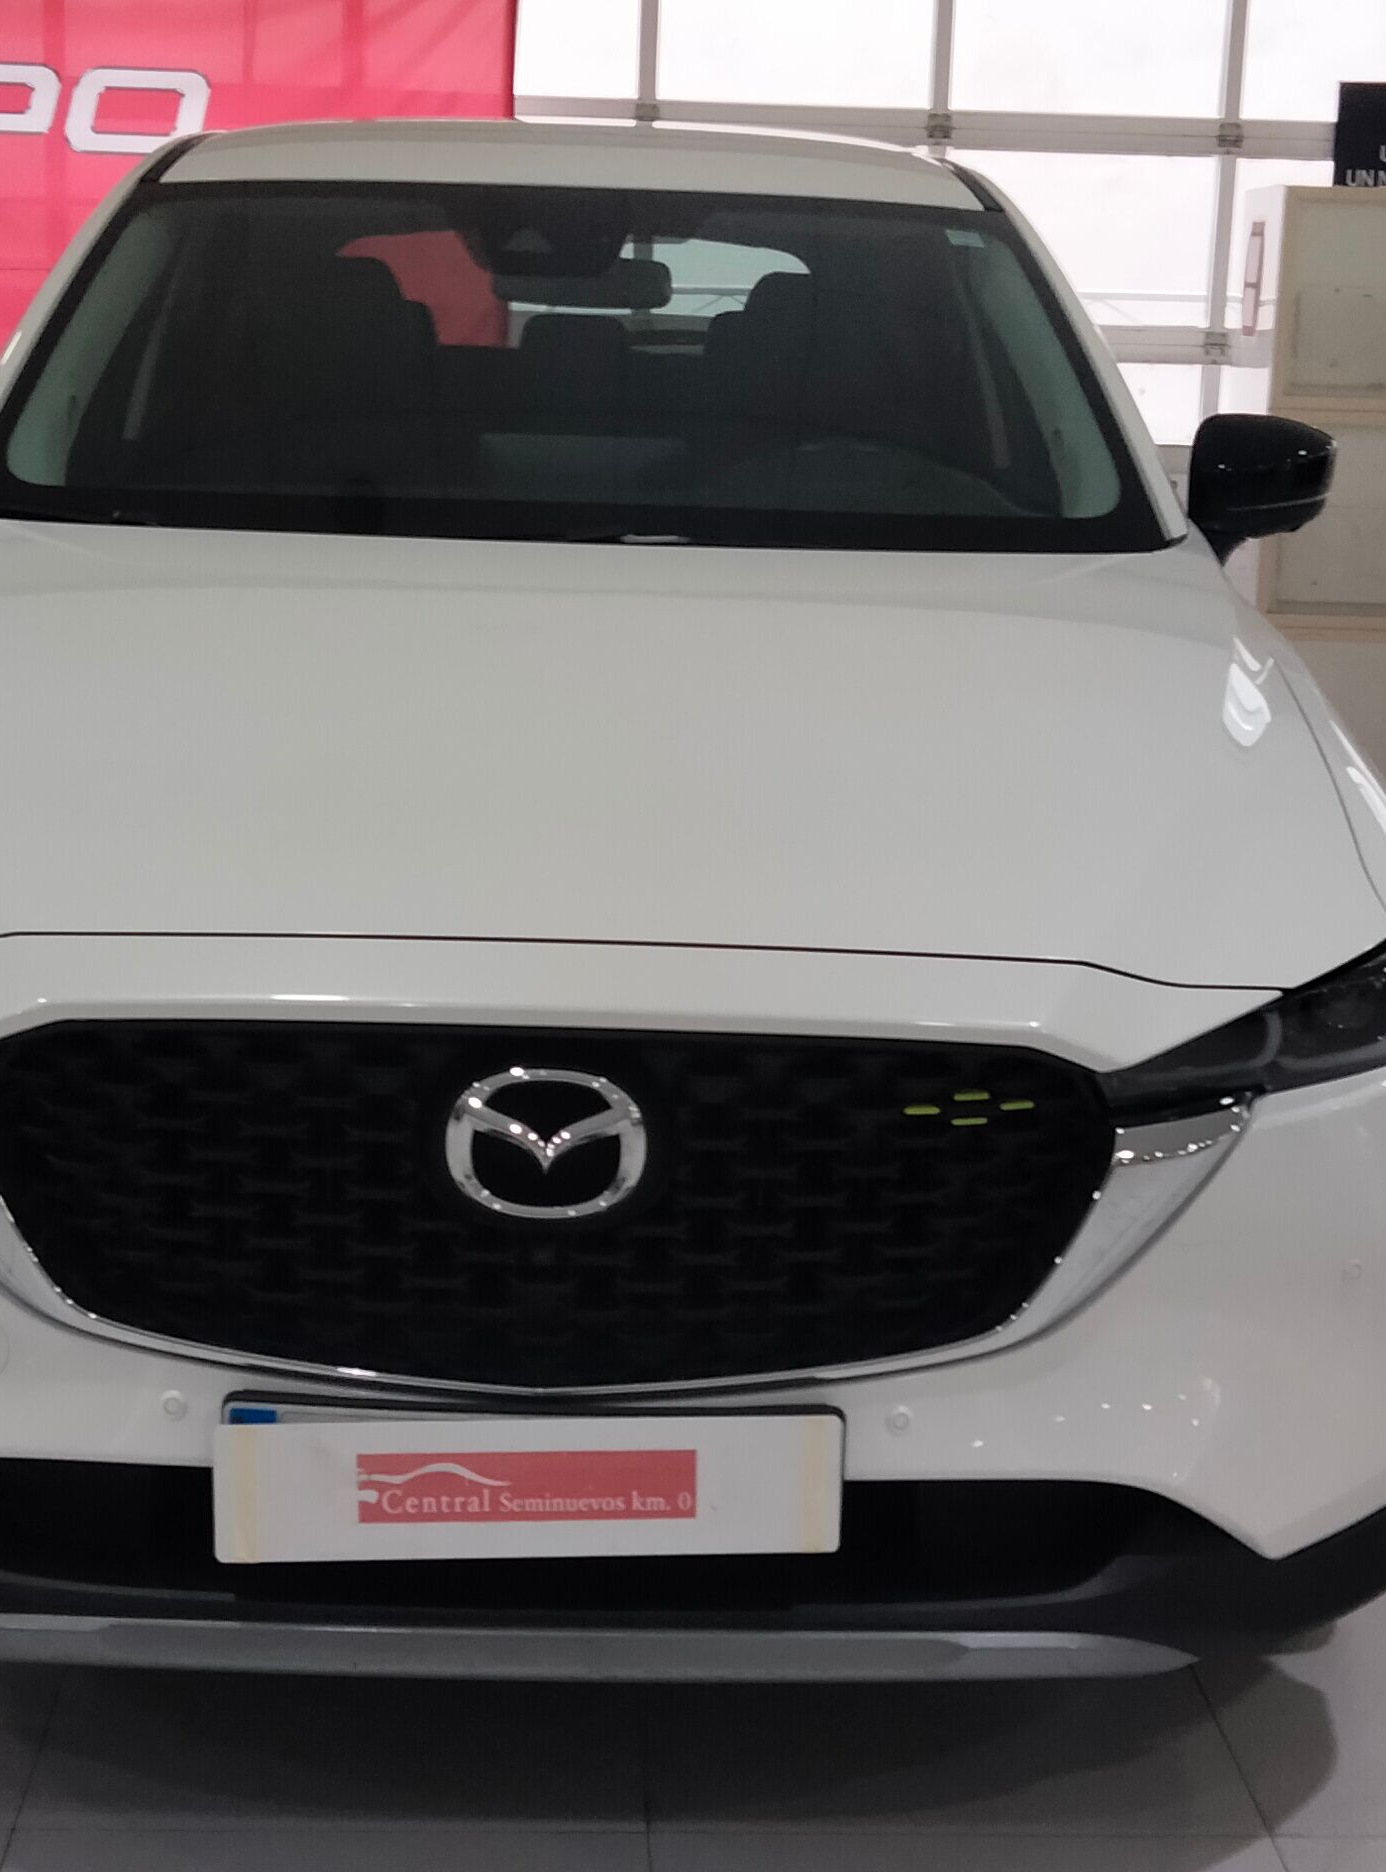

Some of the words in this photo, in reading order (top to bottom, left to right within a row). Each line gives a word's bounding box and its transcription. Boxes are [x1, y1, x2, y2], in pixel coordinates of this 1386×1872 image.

[1345, 168, 1375, 188] UN
[381, 1488, 491, 1515] Central
[499, 1490, 625, 1513] Seminuevos
[632, 1490, 671, 1512] km.
[677, 1490, 693, 1511] 0
